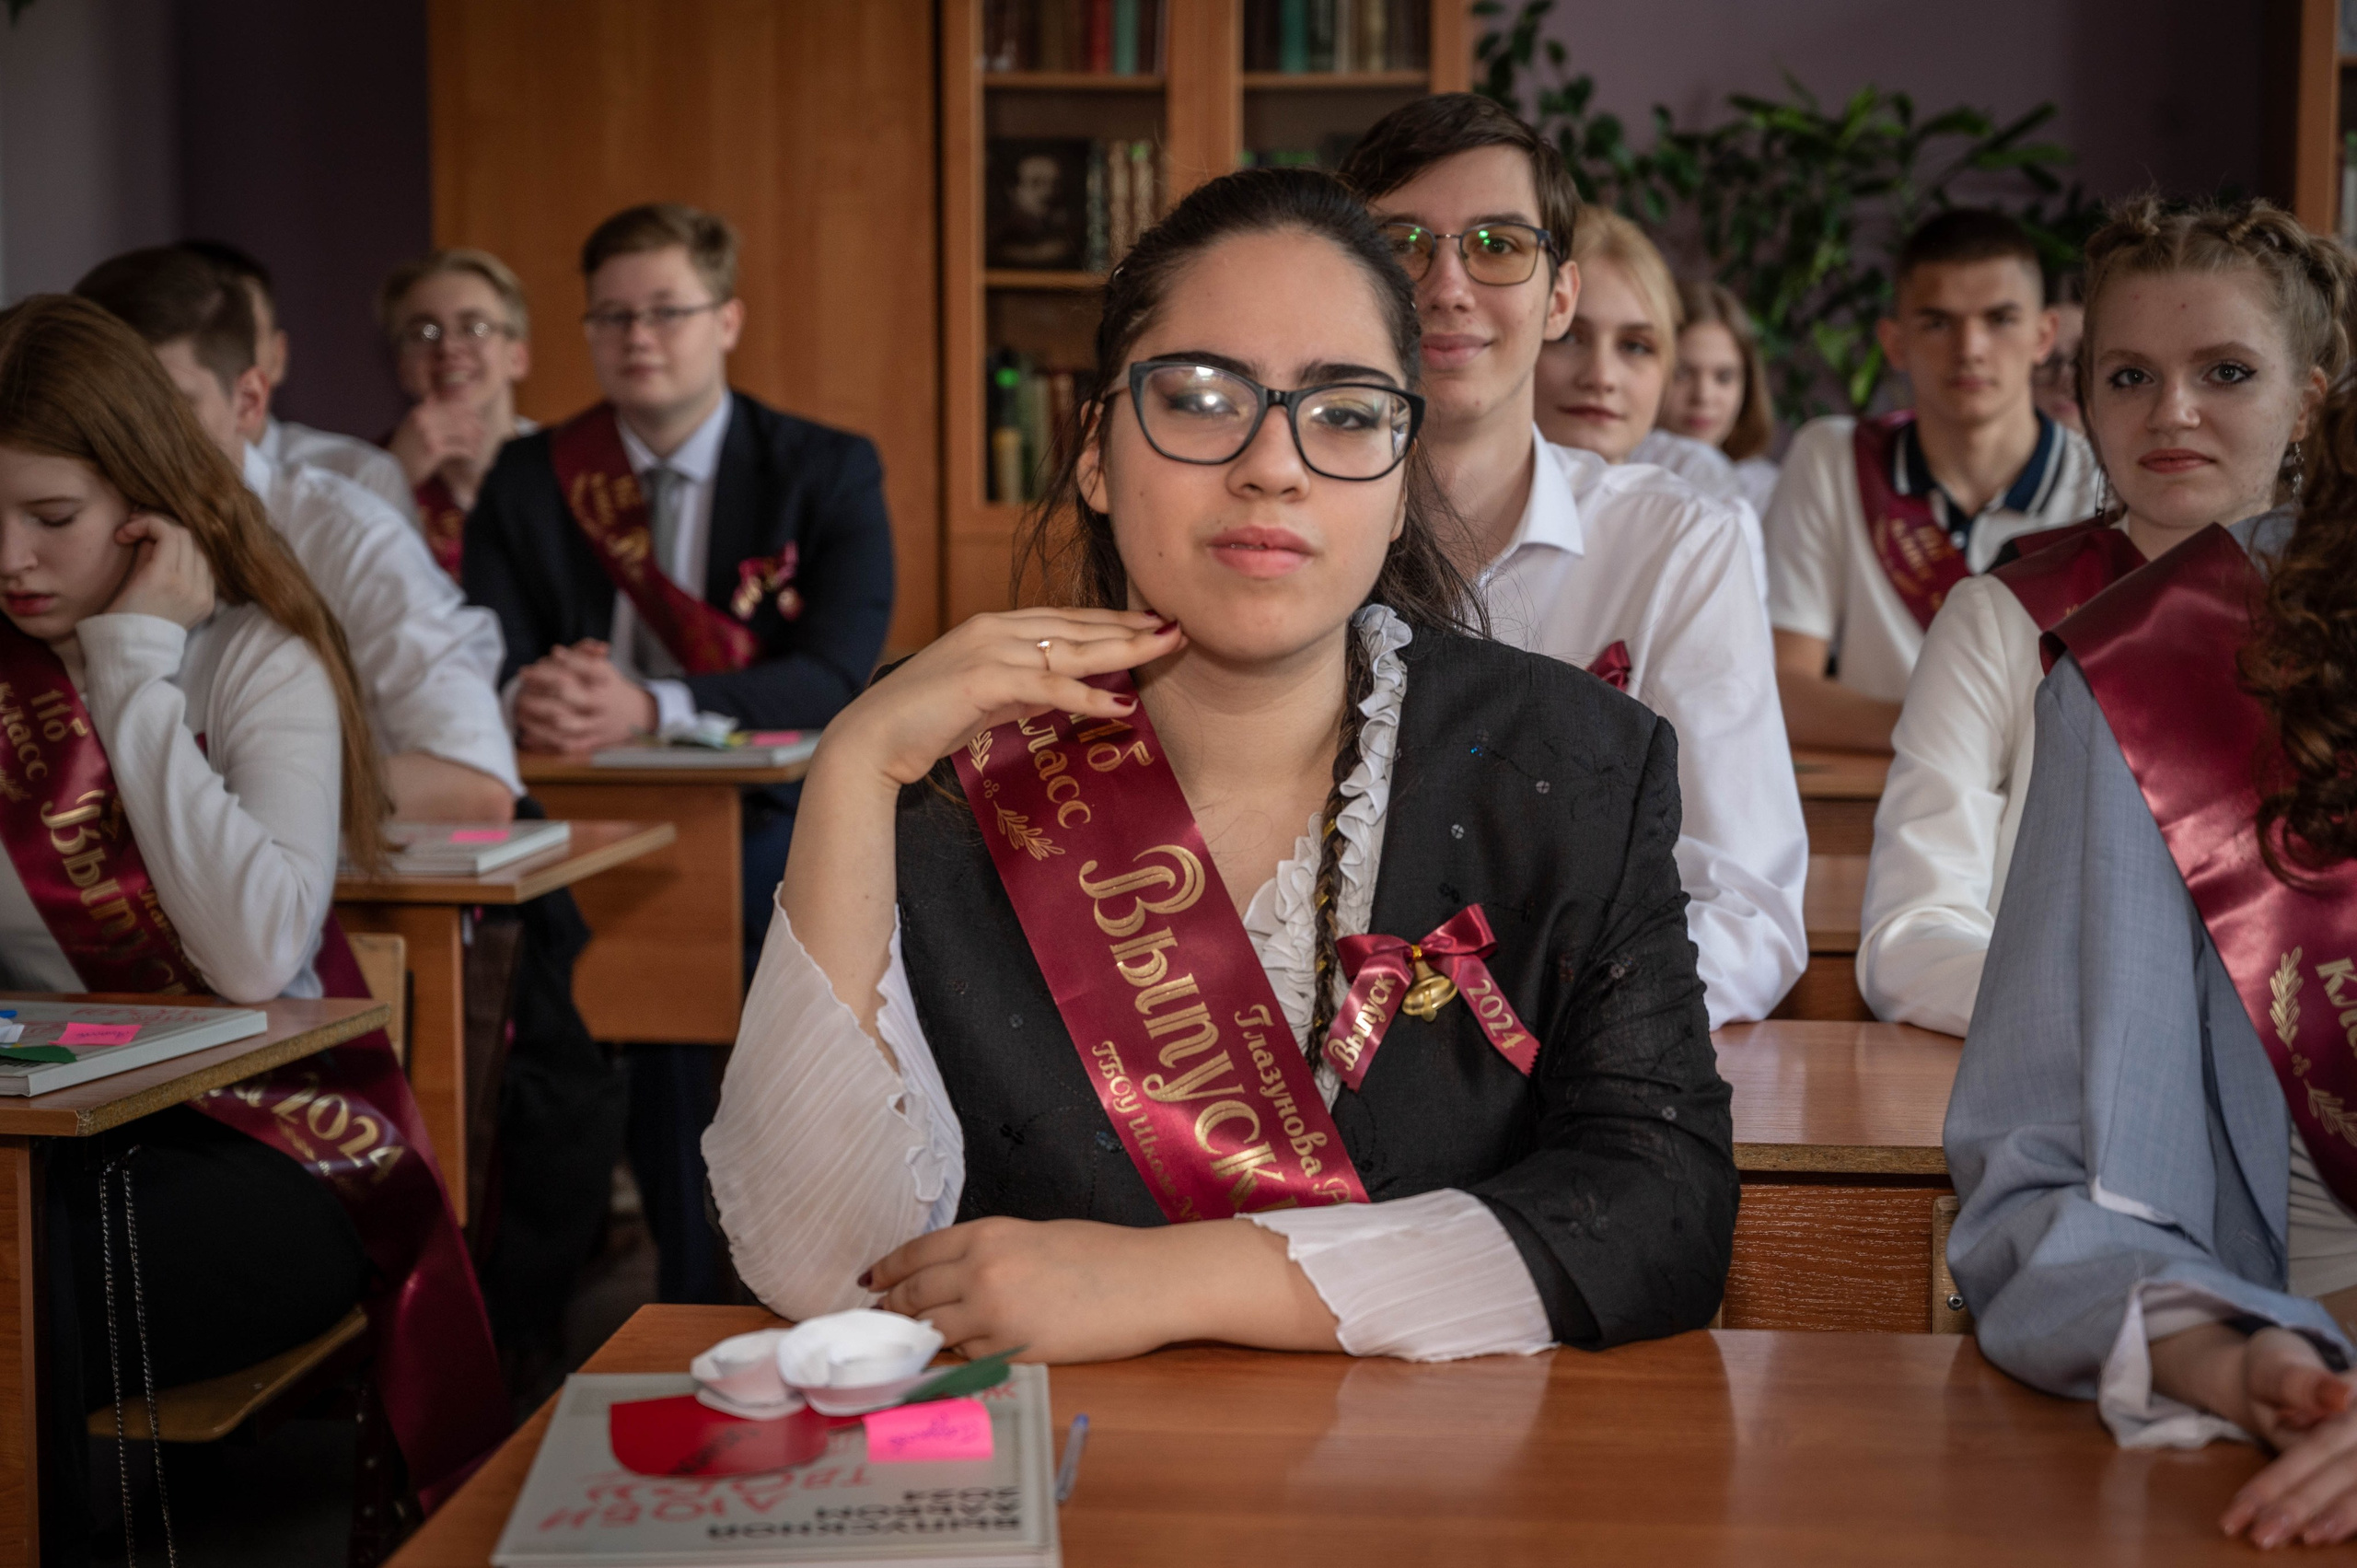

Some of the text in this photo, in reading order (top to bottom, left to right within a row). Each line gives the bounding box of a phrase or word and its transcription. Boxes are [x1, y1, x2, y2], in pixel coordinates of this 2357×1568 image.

[30, 689, 88, 742] 11б
[1016, 717, 1092, 829] ласс
[1079, 843, 1298, 1213] Выпуск
[1328, 973, 1397, 1072] Выпуск
[1466, 978, 1527, 1050] 2024
[270, 1071, 406, 1185] 2024
[1091, 1040, 1144, 1114] ГБОУ
[1129, 1113, 1181, 1197] Школа
[1234, 1003, 1328, 1179] Глазунова
